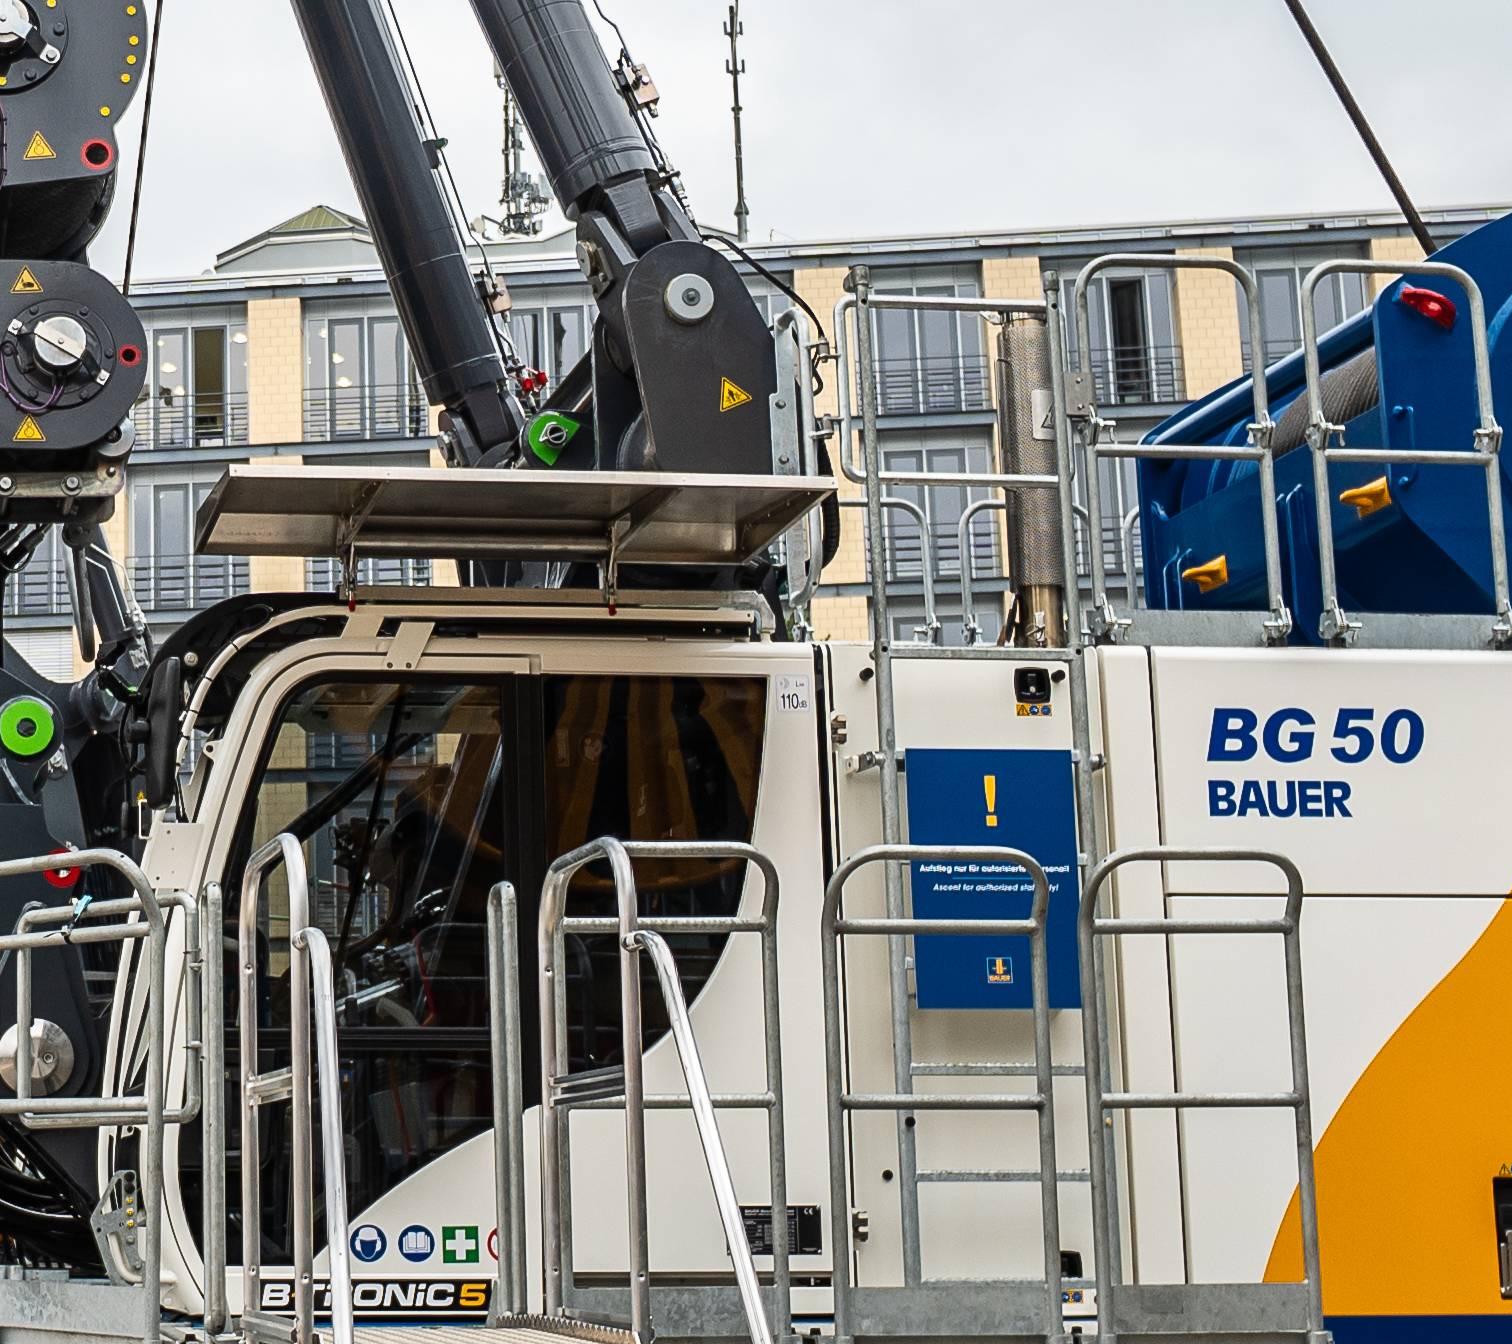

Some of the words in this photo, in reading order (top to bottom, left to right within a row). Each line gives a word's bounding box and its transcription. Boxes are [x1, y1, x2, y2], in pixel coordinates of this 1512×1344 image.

[1207, 707, 1316, 764] BG
[1330, 708, 1425, 764] 50
[1207, 779, 1354, 819] BAUER
[981, 864, 1026, 873] autorisierte
[459, 1283, 487, 1306] 5
